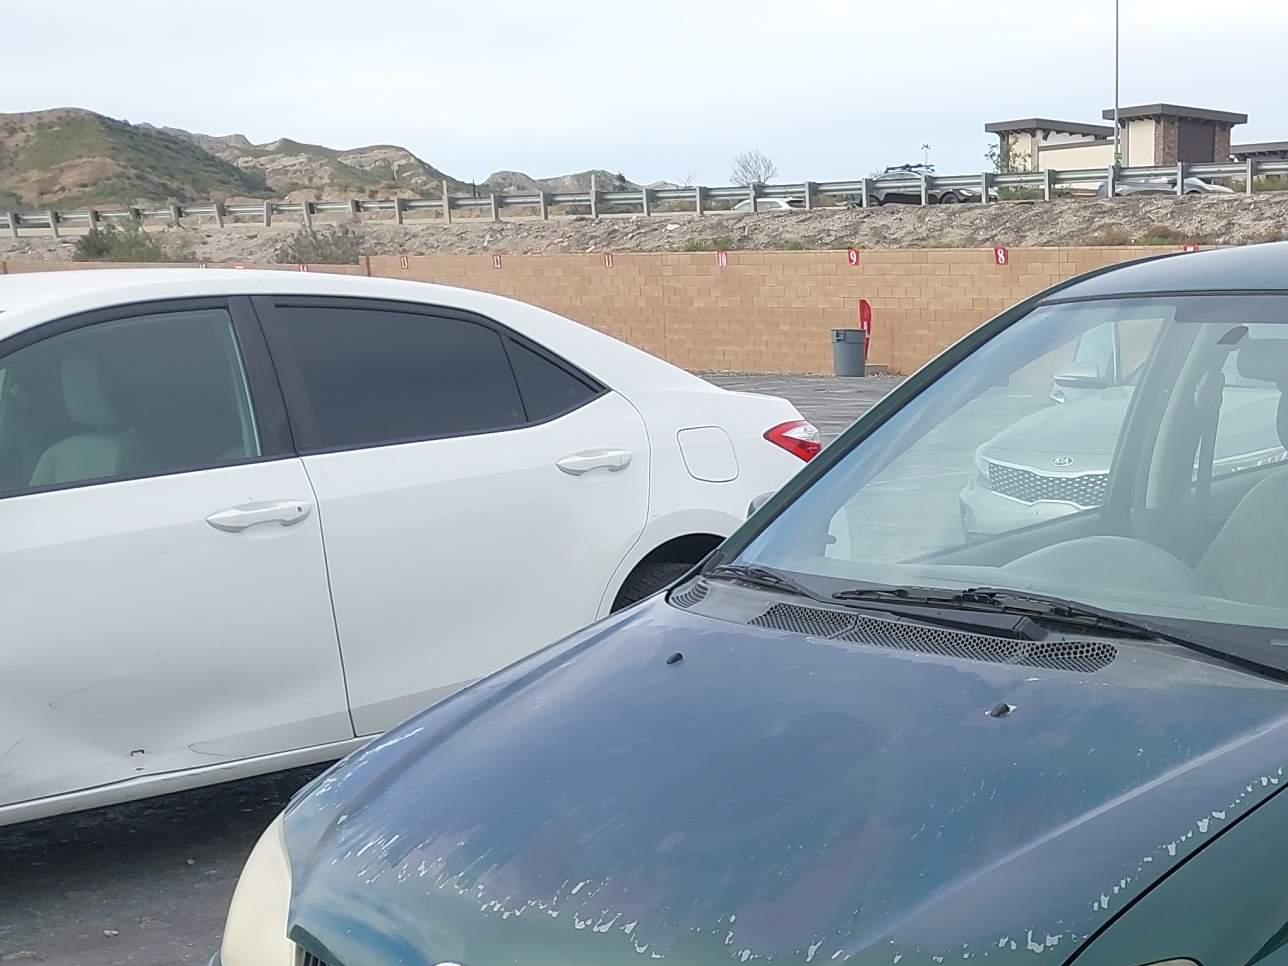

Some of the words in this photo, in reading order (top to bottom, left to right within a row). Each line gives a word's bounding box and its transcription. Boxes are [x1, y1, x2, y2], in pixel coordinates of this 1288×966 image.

[605, 254, 613, 268] 11
[718, 252, 727, 266] 10
[849, 249, 857, 265] 9
[997, 248, 1006, 264] 8
[1053, 456, 1072, 466] KIA
